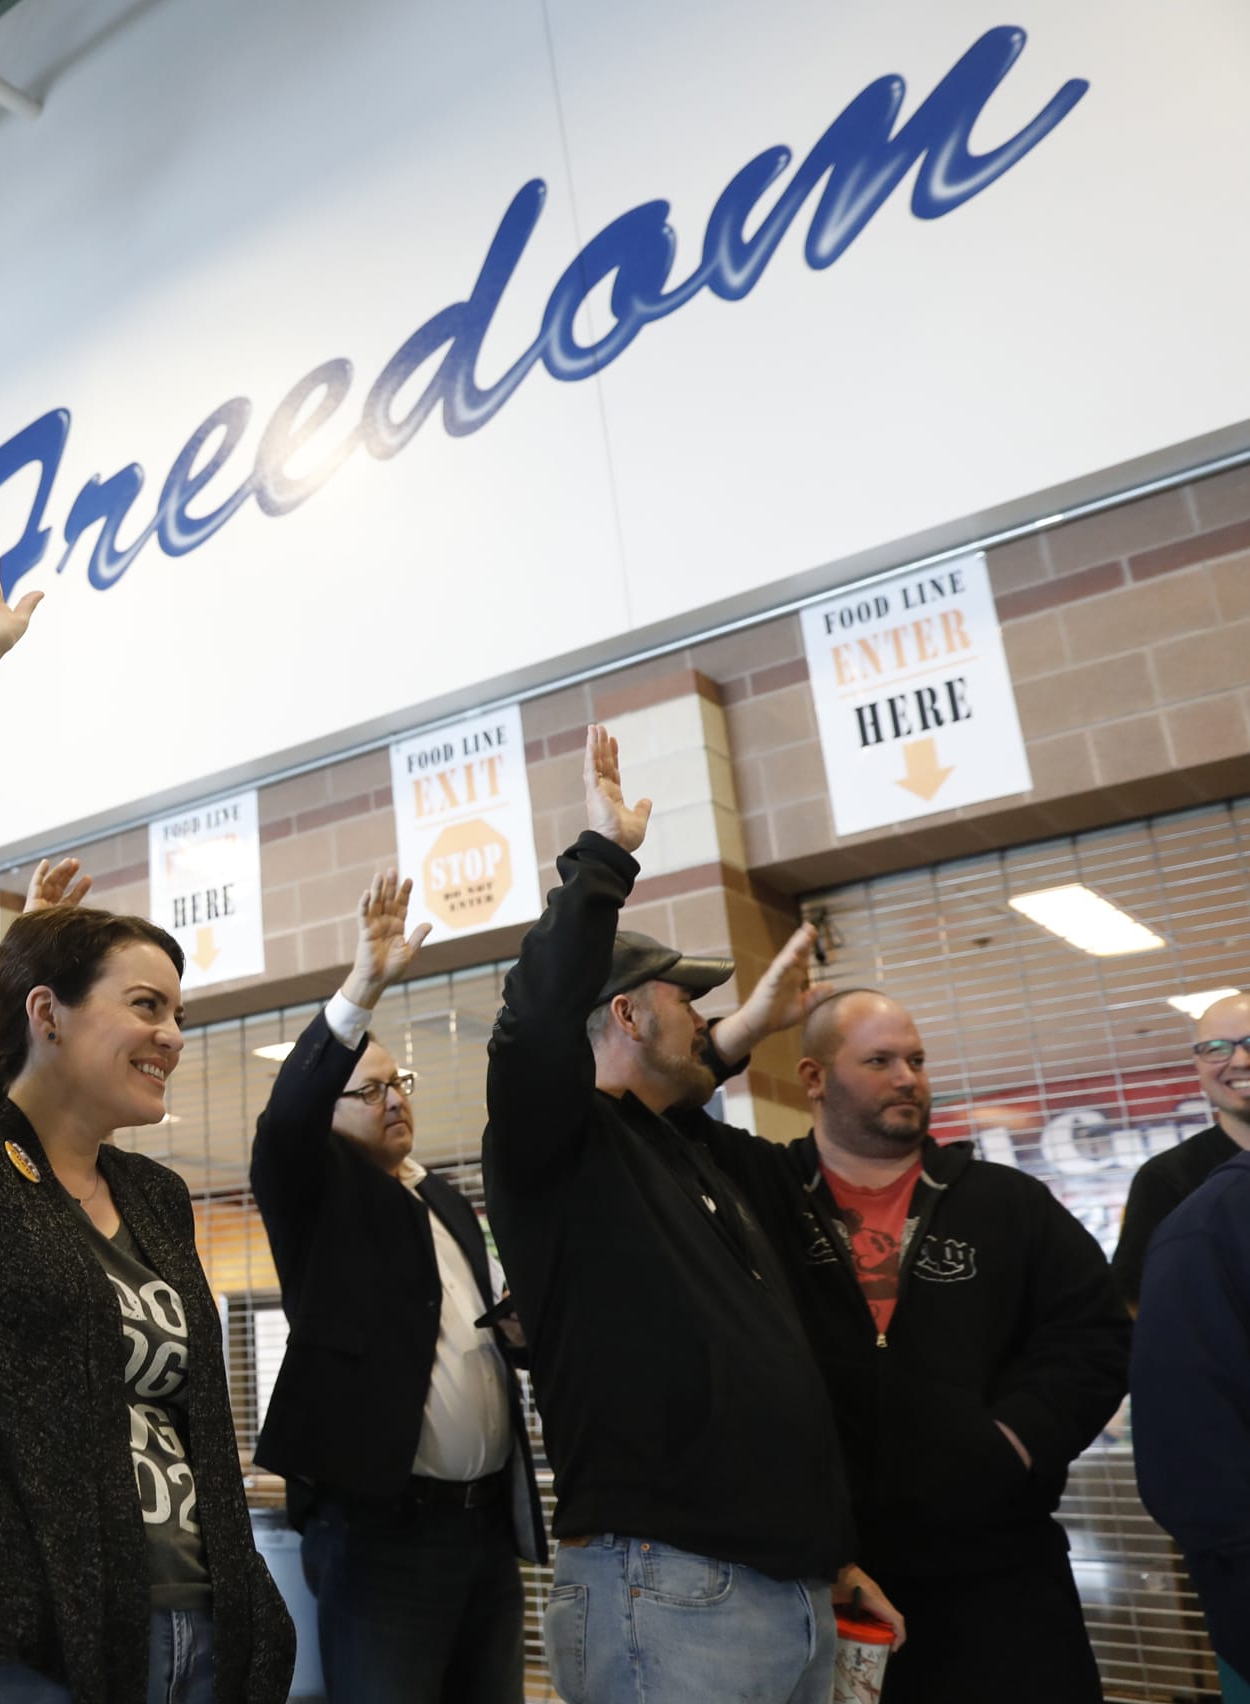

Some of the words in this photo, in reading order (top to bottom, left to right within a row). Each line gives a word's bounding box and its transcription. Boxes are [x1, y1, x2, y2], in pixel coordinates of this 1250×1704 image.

[824, 595, 890, 635] FOOD
[902, 569, 966, 610] LINE
[831, 608, 972, 687] ENTER
[855, 676, 972, 747] HERE
[407, 743, 454, 774] FOOD
[463, 725, 508, 757] LINE
[413, 754, 504, 819] EXIT
[163, 817, 201, 841] FOOD
[206, 803, 241, 830] LINE
[430, 841, 503, 892] STOP
[173, 883, 235, 929] HERE
